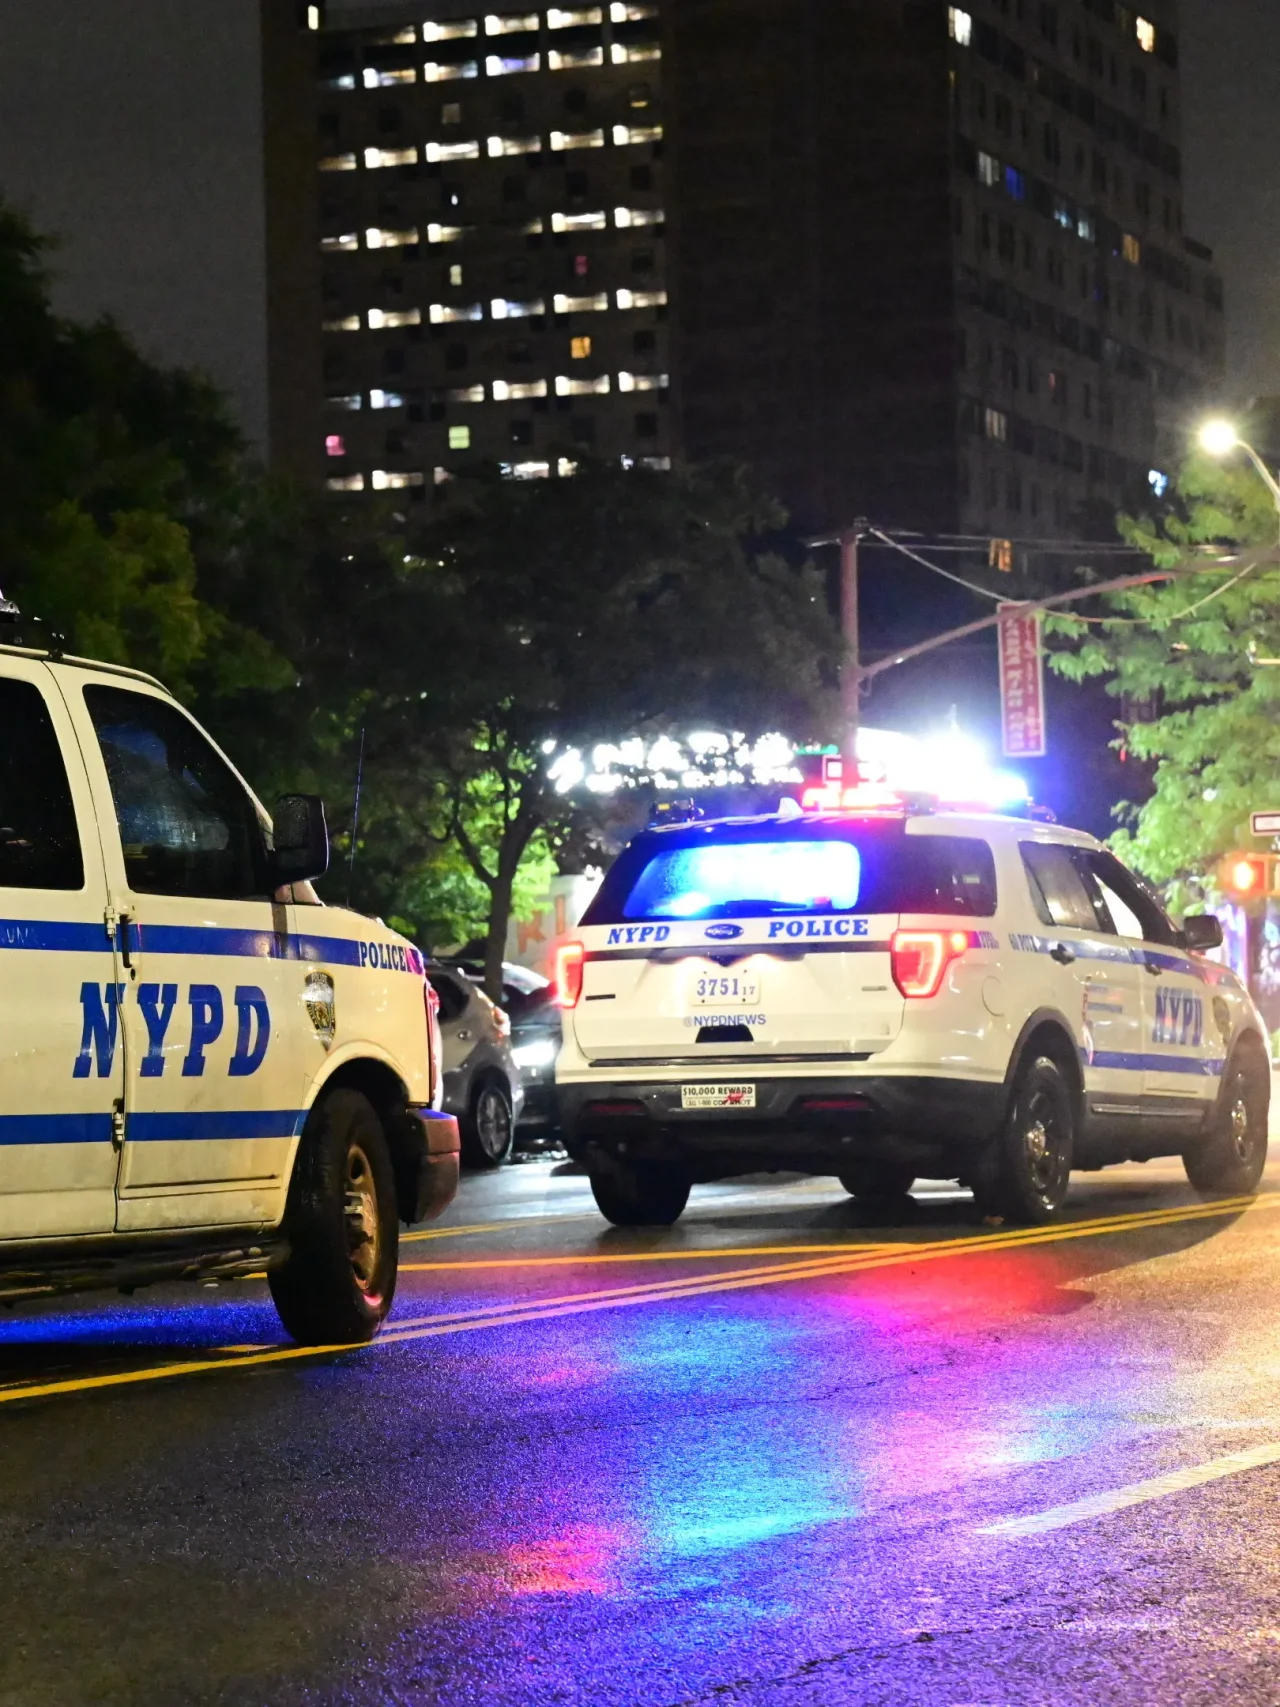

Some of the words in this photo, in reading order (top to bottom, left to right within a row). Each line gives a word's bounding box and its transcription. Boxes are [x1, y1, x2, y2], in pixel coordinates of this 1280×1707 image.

[607, 925, 671, 945] NYPD
[767, 919, 869, 938] POLICE
[359, 941, 407, 972] POLICE
[683, 1014, 766, 1028] @NYPDNEWS
[1152, 985, 1202, 1047] NYPD
[72, 982, 271, 1078] NYPD
[718, 1086, 753, 1095] REWARD
